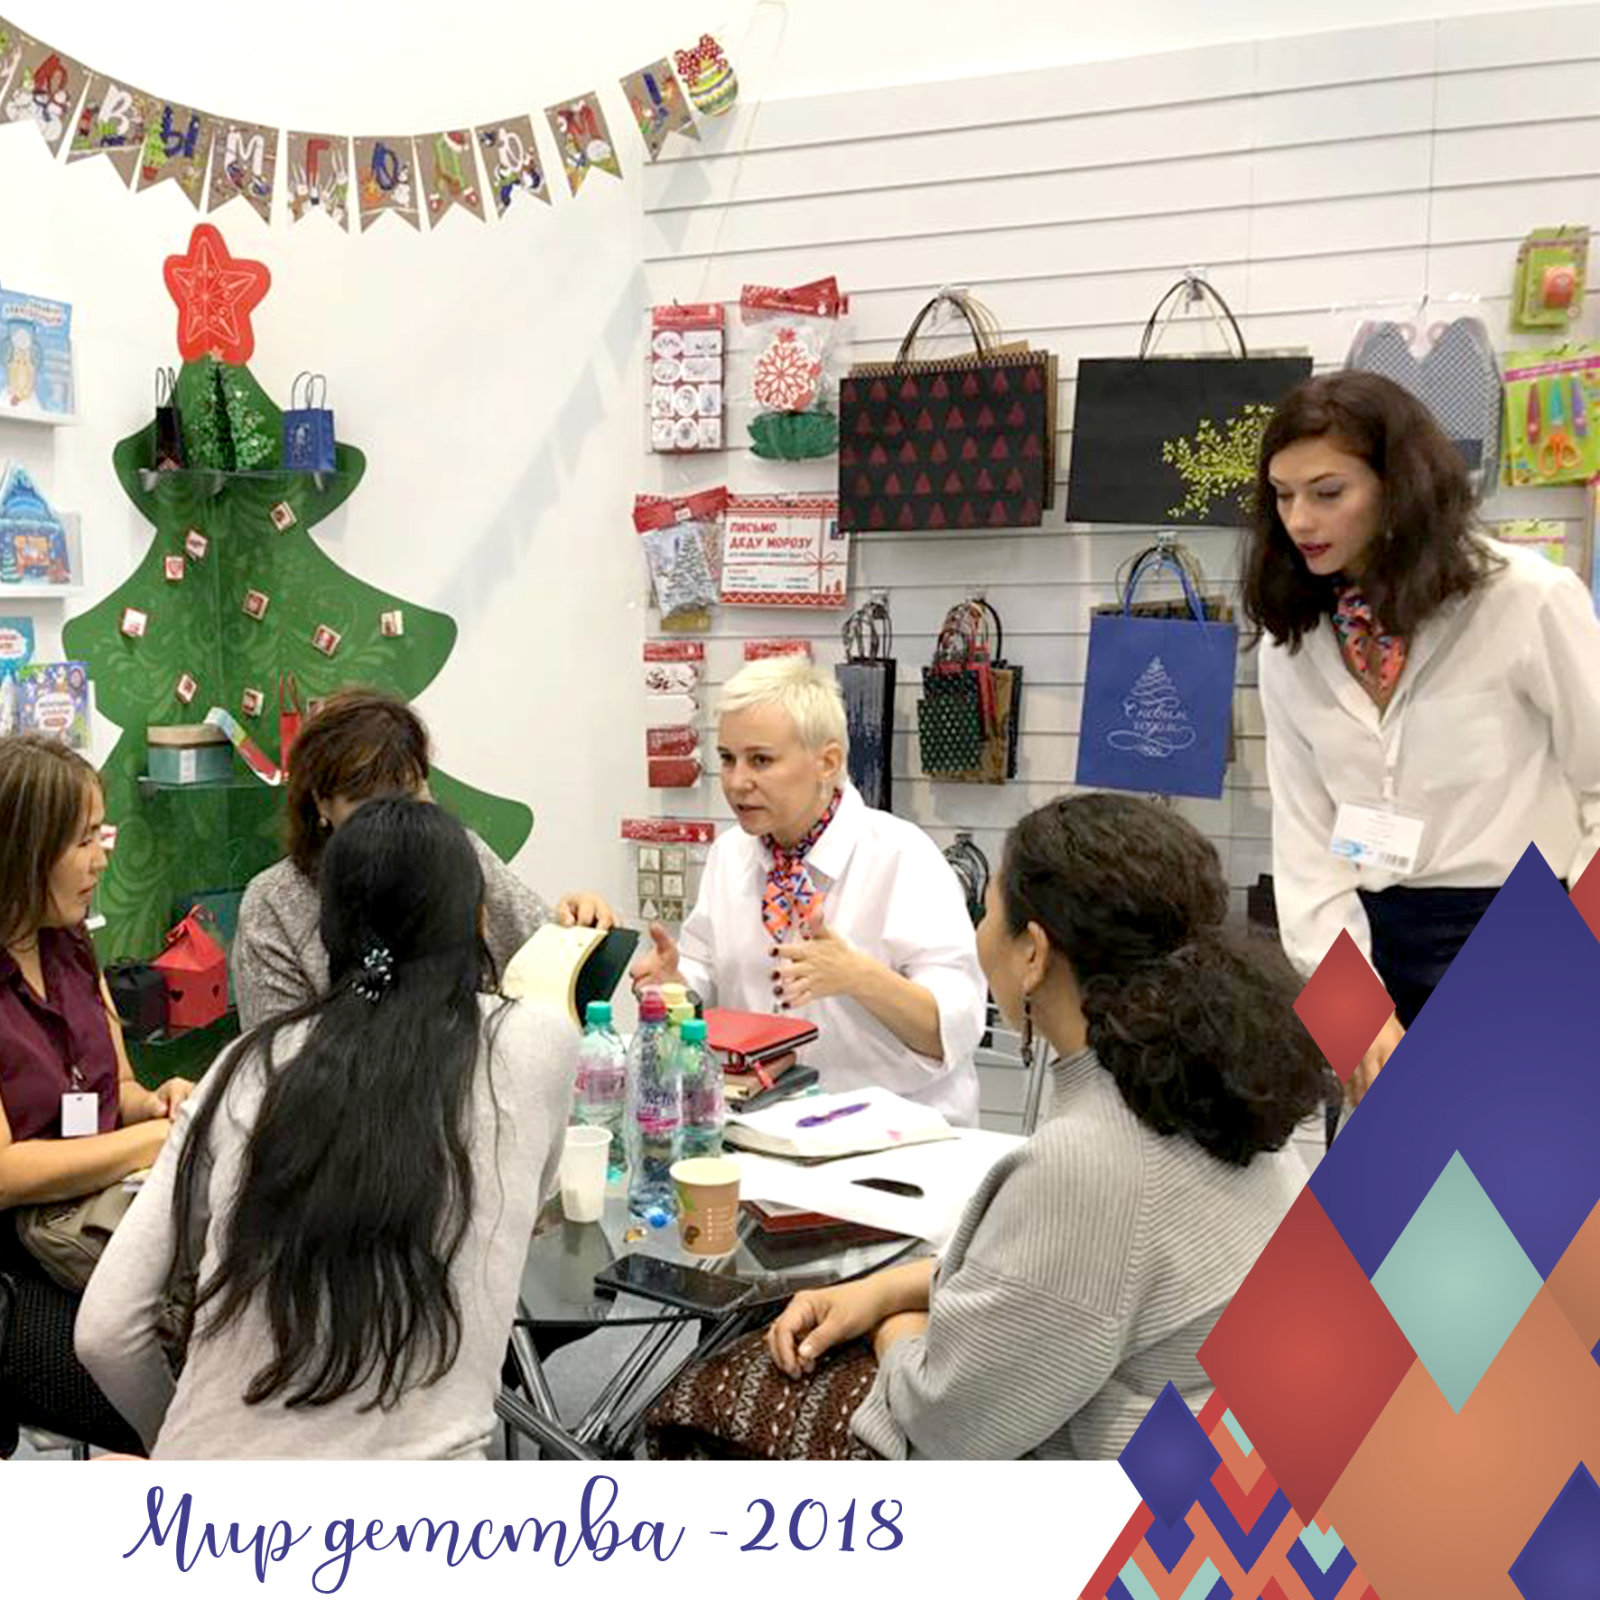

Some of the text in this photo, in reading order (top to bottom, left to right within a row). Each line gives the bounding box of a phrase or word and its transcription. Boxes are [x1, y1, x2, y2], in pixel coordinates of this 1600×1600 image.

[729, 521, 777, 533] ПИСЬМО
[729, 536, 813, 550] ДЕДУ МОРОЗУ
